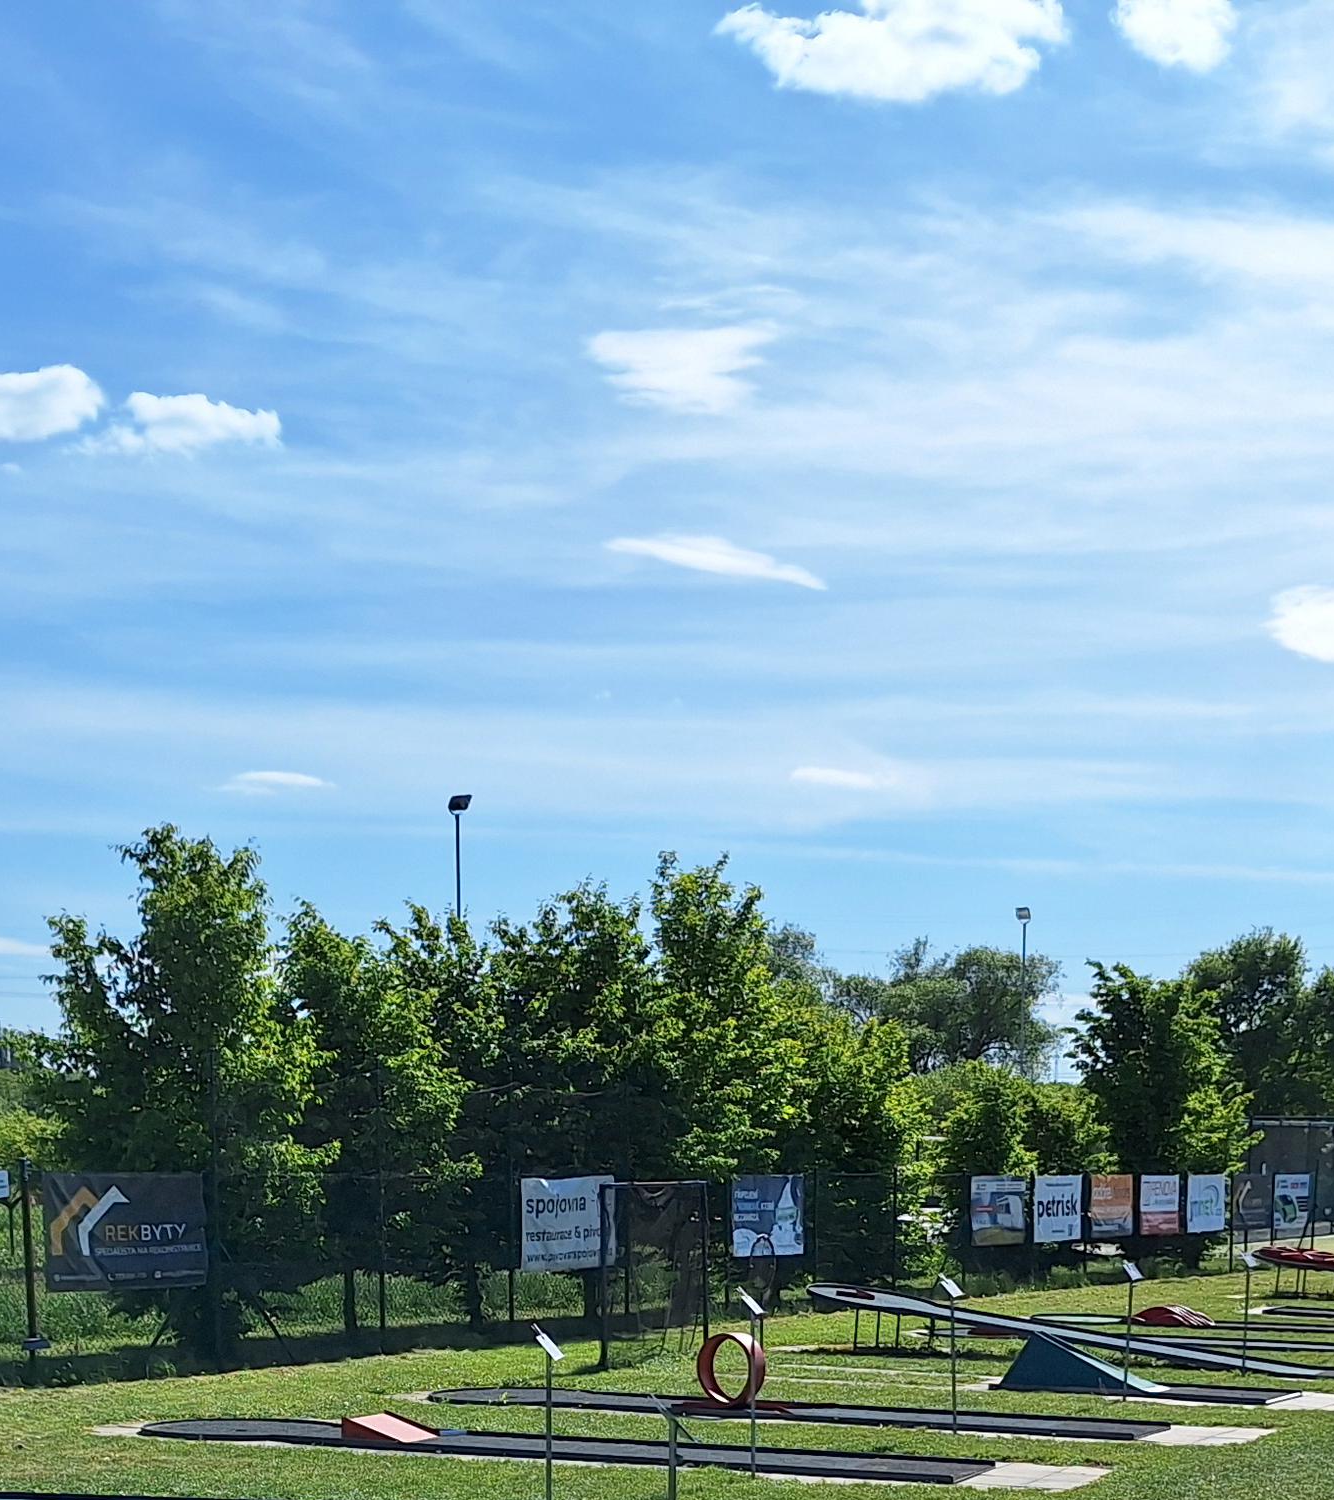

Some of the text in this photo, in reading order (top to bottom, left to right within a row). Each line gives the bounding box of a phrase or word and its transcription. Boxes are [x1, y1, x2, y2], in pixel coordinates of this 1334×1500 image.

[525, 1194, 587, 1219] spojovna
[1037, 1193, 1078, 1226] petrisk
[104, 1223, 187, 1242] REKBYTY
[525, 1228, 573, 1243] restaurace
[573, 1225, 581, 1240] &
[137, 1246, 148, 1254] NA
